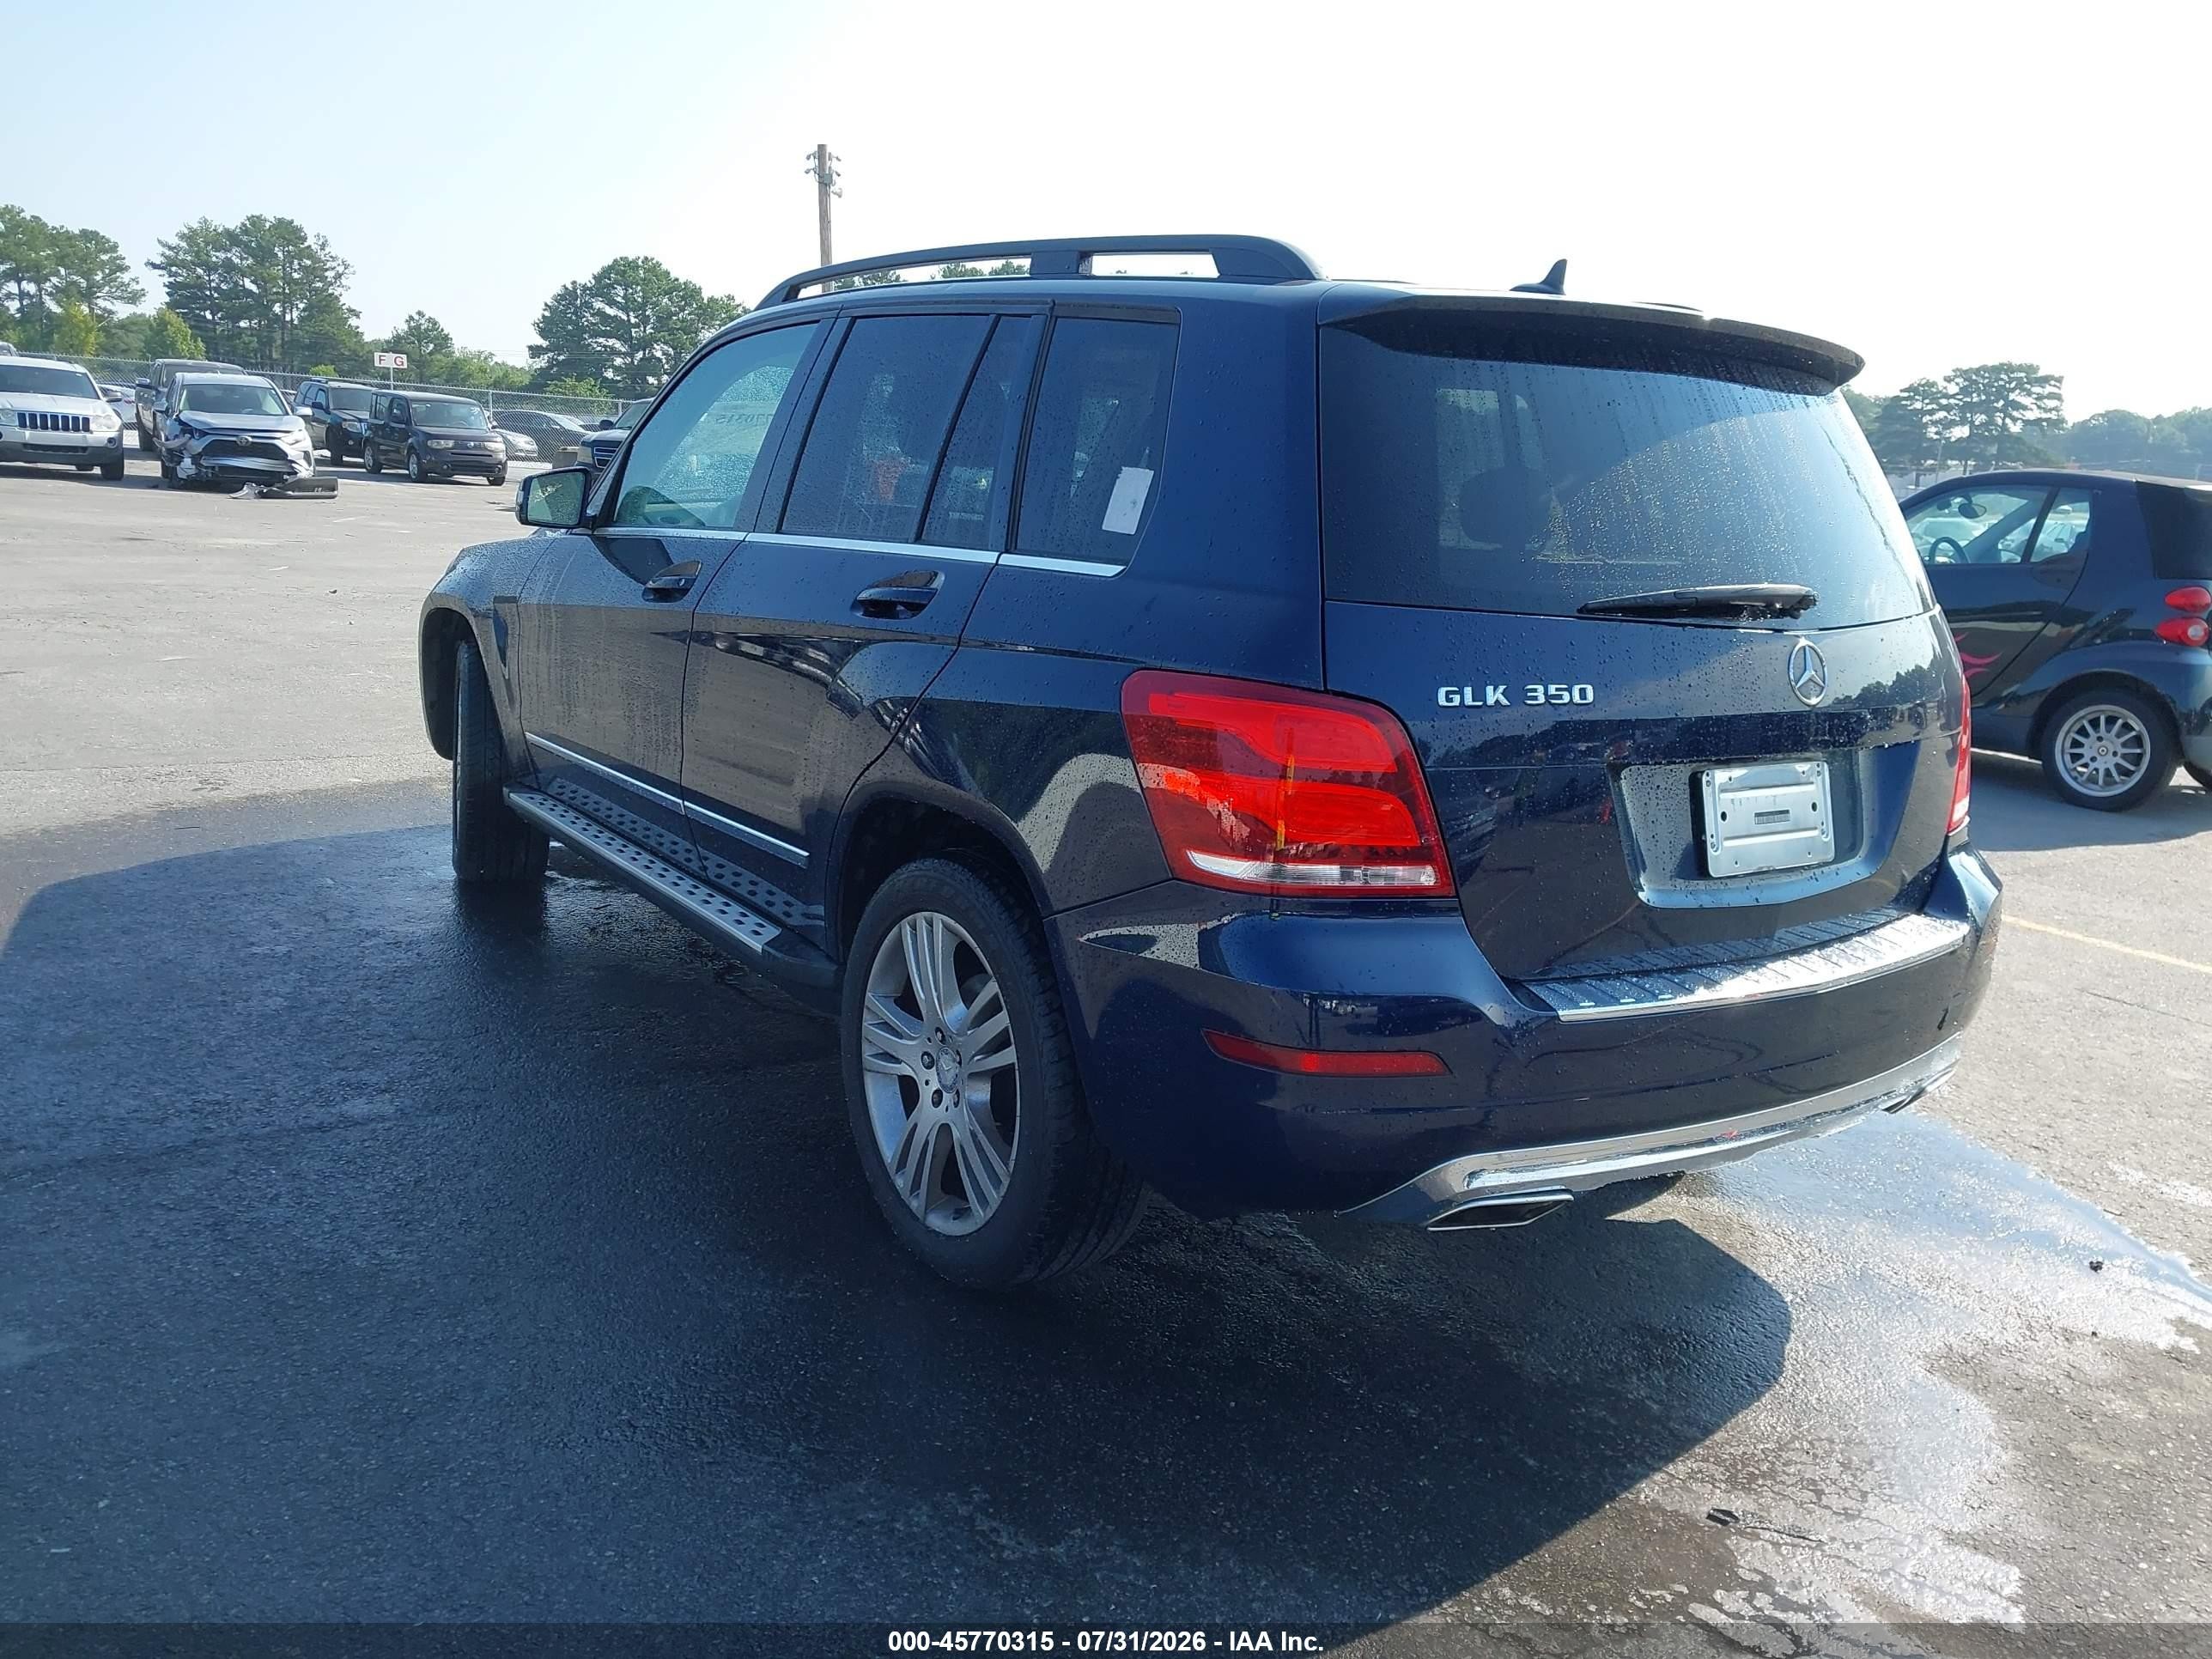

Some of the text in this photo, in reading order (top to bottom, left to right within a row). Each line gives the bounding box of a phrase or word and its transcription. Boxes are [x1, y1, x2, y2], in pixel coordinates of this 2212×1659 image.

[378, 355, 404, 367] F G
[1437, 684, 1594, 707] GLK 350
